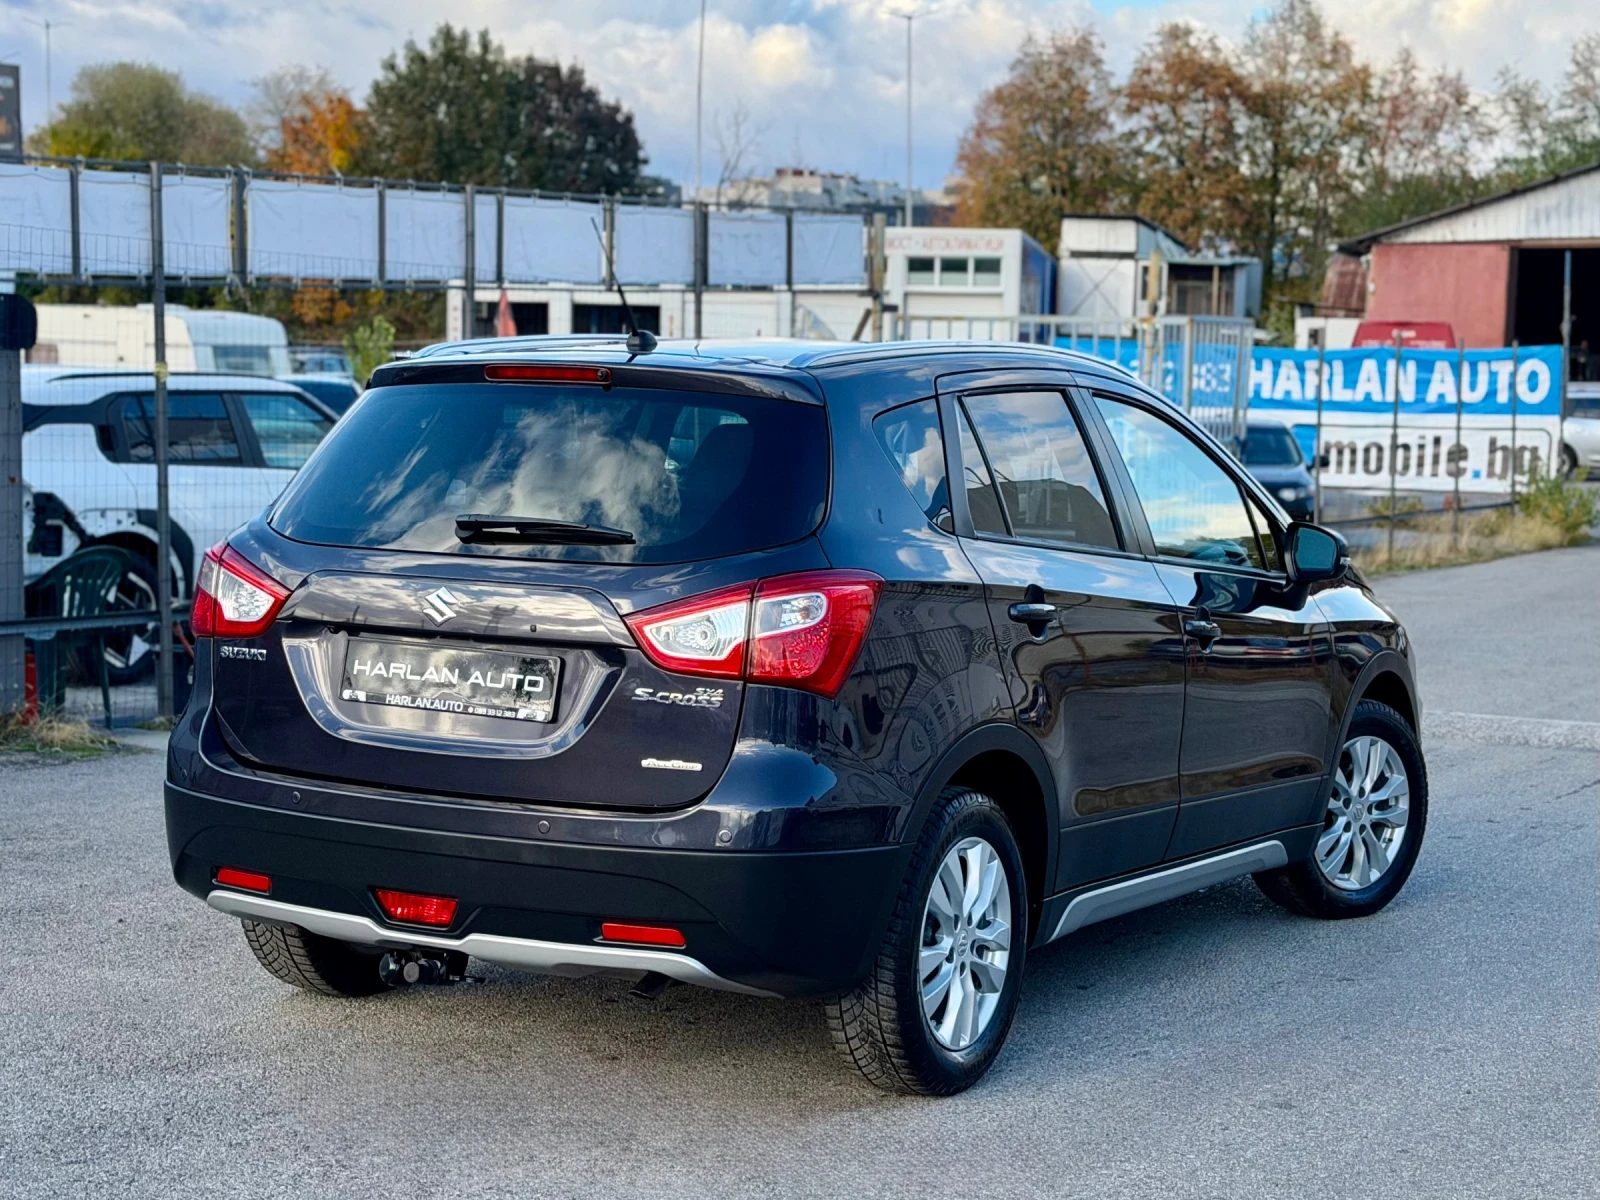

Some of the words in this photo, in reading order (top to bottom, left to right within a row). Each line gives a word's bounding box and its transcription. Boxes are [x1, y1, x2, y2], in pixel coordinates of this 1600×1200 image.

[1249, 358, 1417, 402] HARLAN
[1425, 358, 1551, 404] AUTO
[1323, 436, 1539, 486] mobile.bg
[220, 645, 267, 661] SUZUKI
[353, 659, 459, 684] HARLAN
[467, 671, 545, 692] AUTO
[631, 687, 724, 708] S-CROSS
[694, 687, 724, 697] SX4
[385, 694, 464, 712] HARLAN.AUTO
